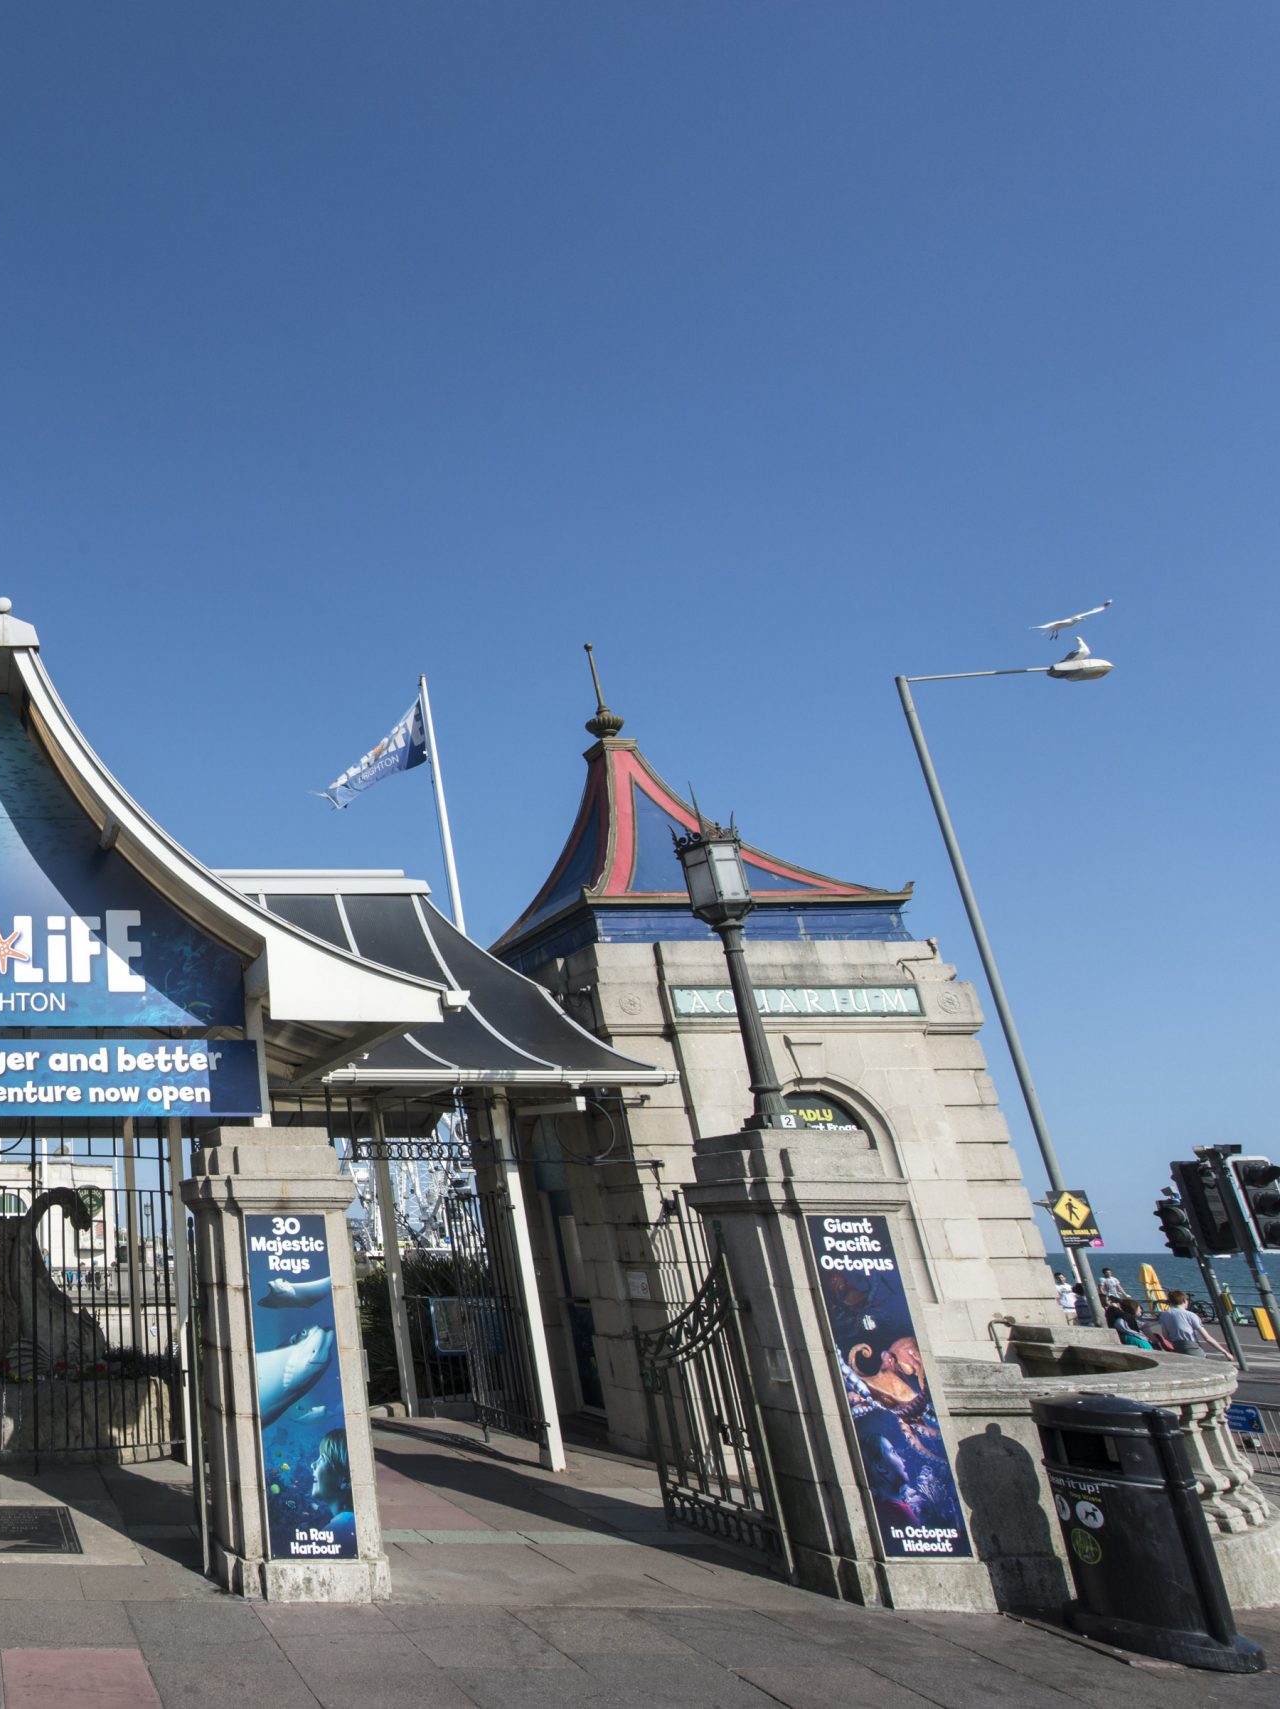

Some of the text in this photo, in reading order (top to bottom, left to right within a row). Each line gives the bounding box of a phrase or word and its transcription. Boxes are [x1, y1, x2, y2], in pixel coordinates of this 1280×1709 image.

[48, 1047, 108, 1073] and
[117, 1046, 222, 1073] better
[88, 1085, 140, 1104] now
[147, 1084, 211, 1110] open
[784, 1116, 793, 1126] 2
[271, 1217, 301, 1235] 30
[823, 1217, 874, 1234] Giant
[250, 1236, 325, 1256] Majestic
[823, 1235, 882, 1252] Pacific
[268, 1255, 311, 1274] Rays
[820, 1254, 894, 1276] Octopus
[295, 1528, 335, 1544] in Ray
[890, 1525, 959, 1542] in Octopus
[290, 1541, 342, 1555] Harbour
[902, 1539, 954, 1553] Hideout
